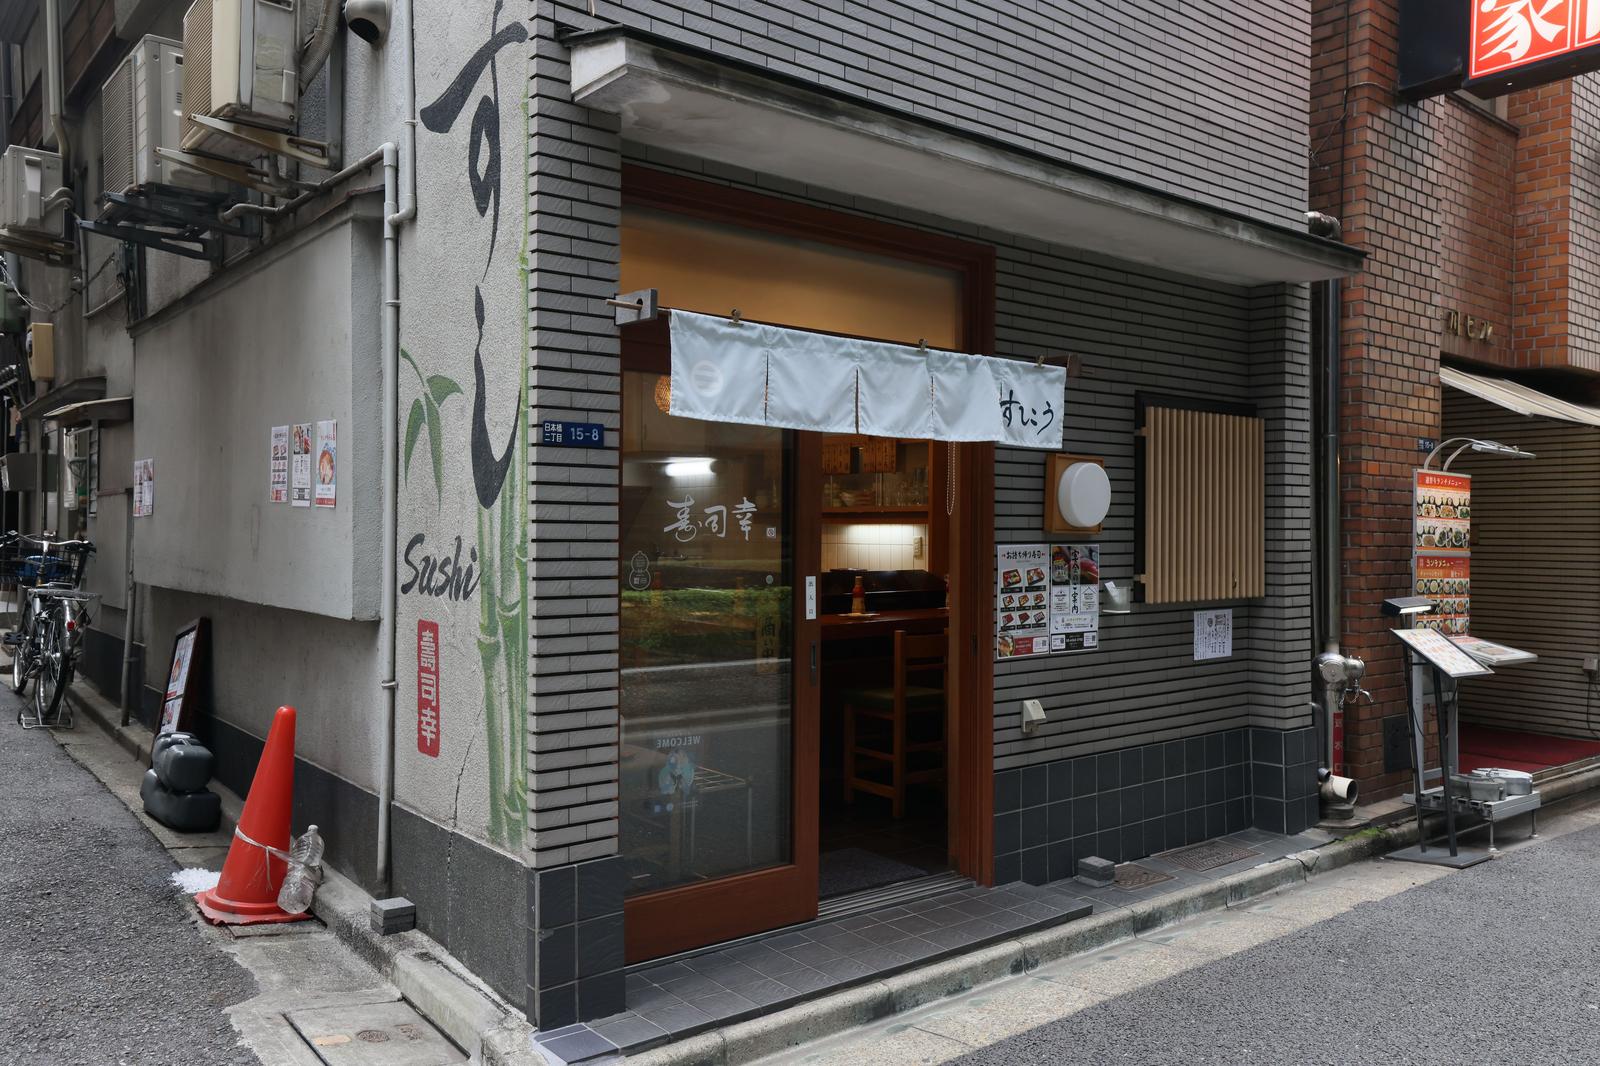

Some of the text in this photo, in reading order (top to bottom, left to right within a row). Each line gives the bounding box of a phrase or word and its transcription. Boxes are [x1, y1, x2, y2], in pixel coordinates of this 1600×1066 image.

[999, 389, 1054, 435] すしこう
[544, 422, 563, 432] 日本橋
[570, 427, 599, 441] 15-8
[544, 433, 563, 443] 二丁目
[400, 532, 483, 601] Sushi
